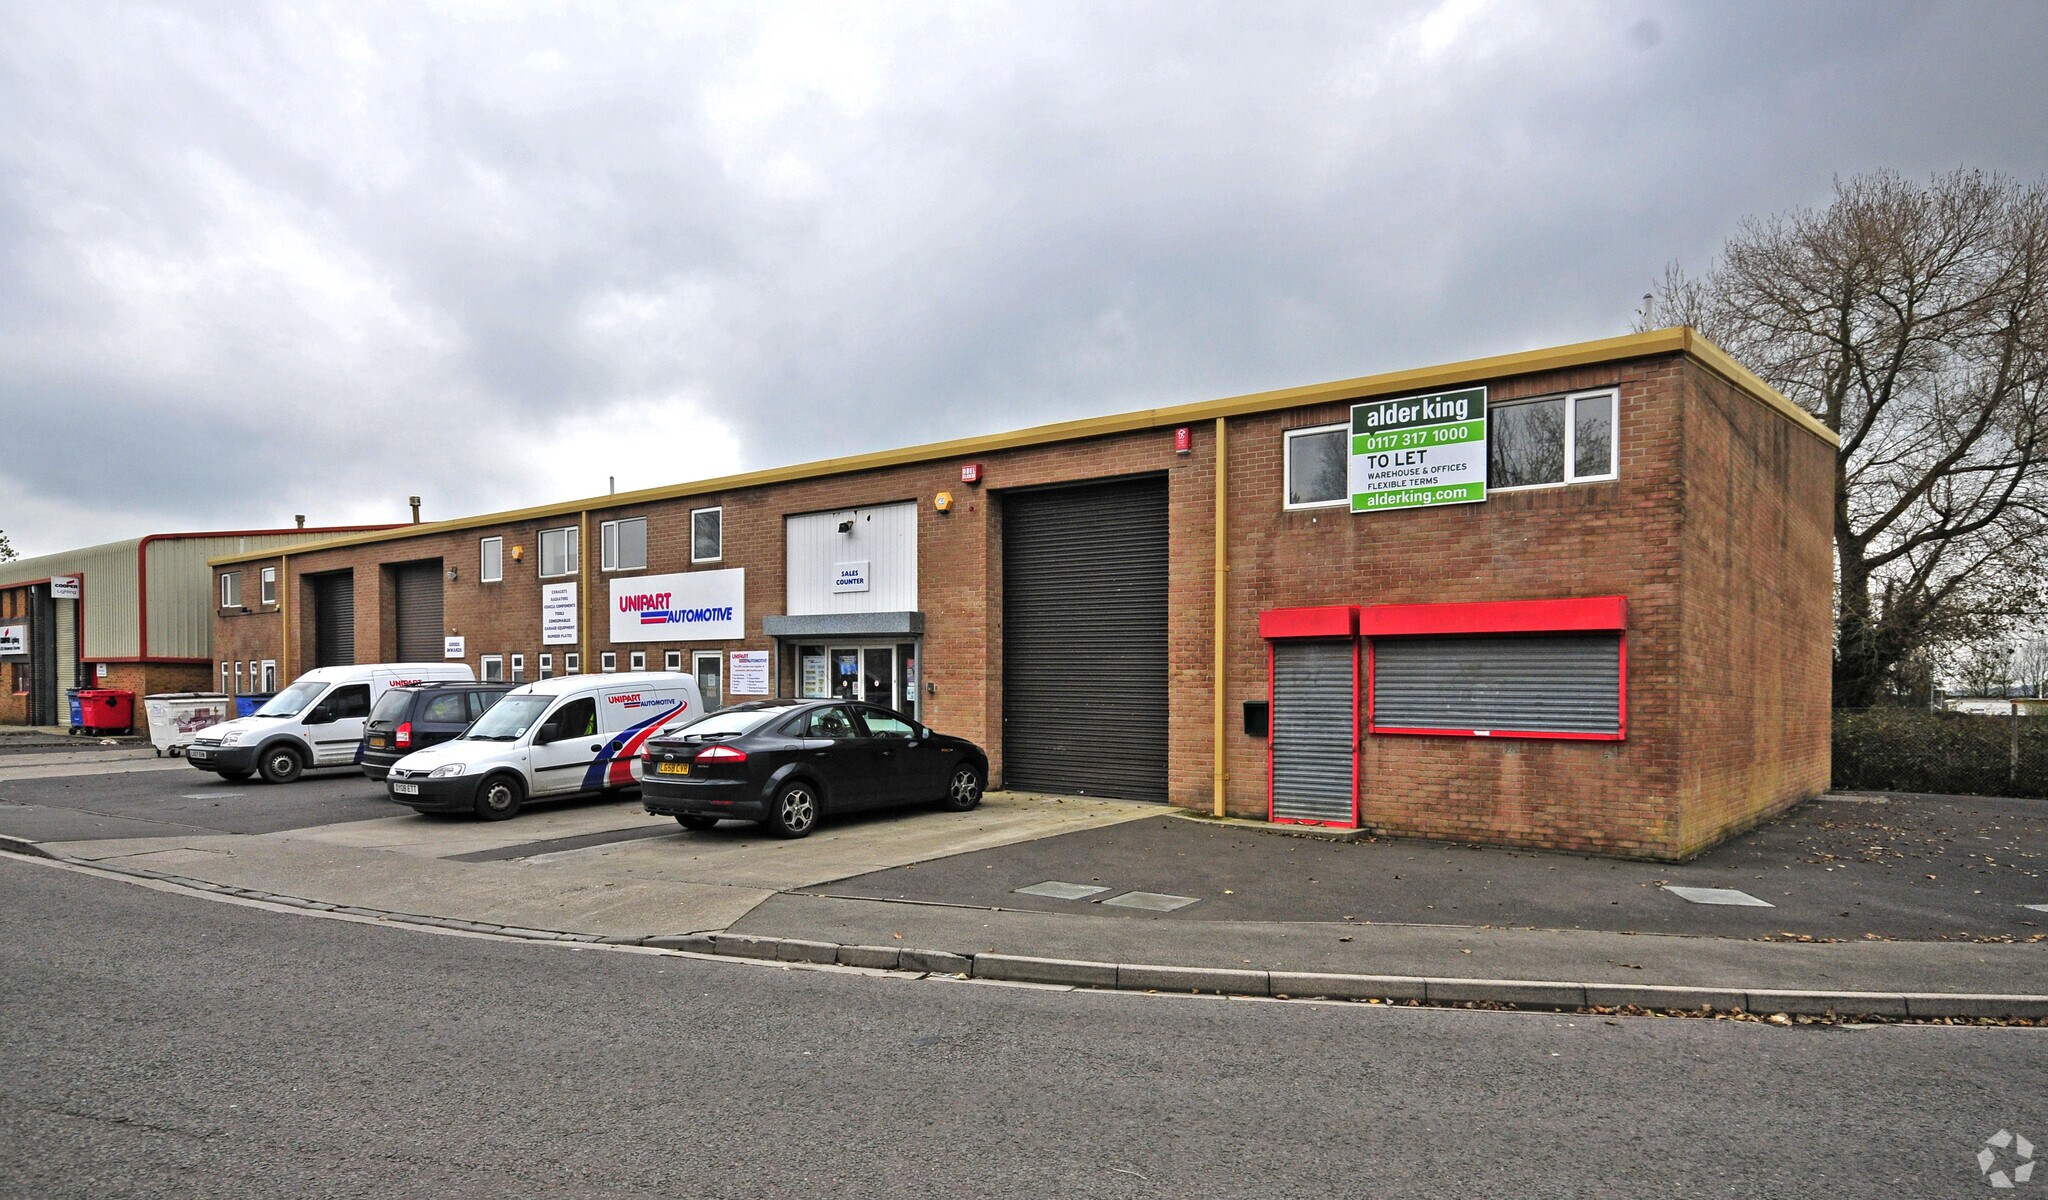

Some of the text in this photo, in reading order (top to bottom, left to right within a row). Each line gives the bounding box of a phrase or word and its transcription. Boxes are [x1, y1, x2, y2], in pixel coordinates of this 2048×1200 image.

[1367, 397, 1468, 427] alder king
[1367, 426, 1468, 450] 0117 317 1000
[1367, 449, 1428, 469] TO LET
[1367, 463, 1467, 480] WAREHOUSE & OFFICES
[1367, 477, 1439, 491] FLEXIBLE TERMS
[1367, 488, 1468, 507] alderking.com
[835, 577, 864, 586] COUNTER
[619, 592, 672, 613] UNIPART
[667, 607, 733, 624] AUTOMOTIVE
[608, 693, 641, 704] UNIPART
[640, 698, 675, 707] AUTOMOTIVE
